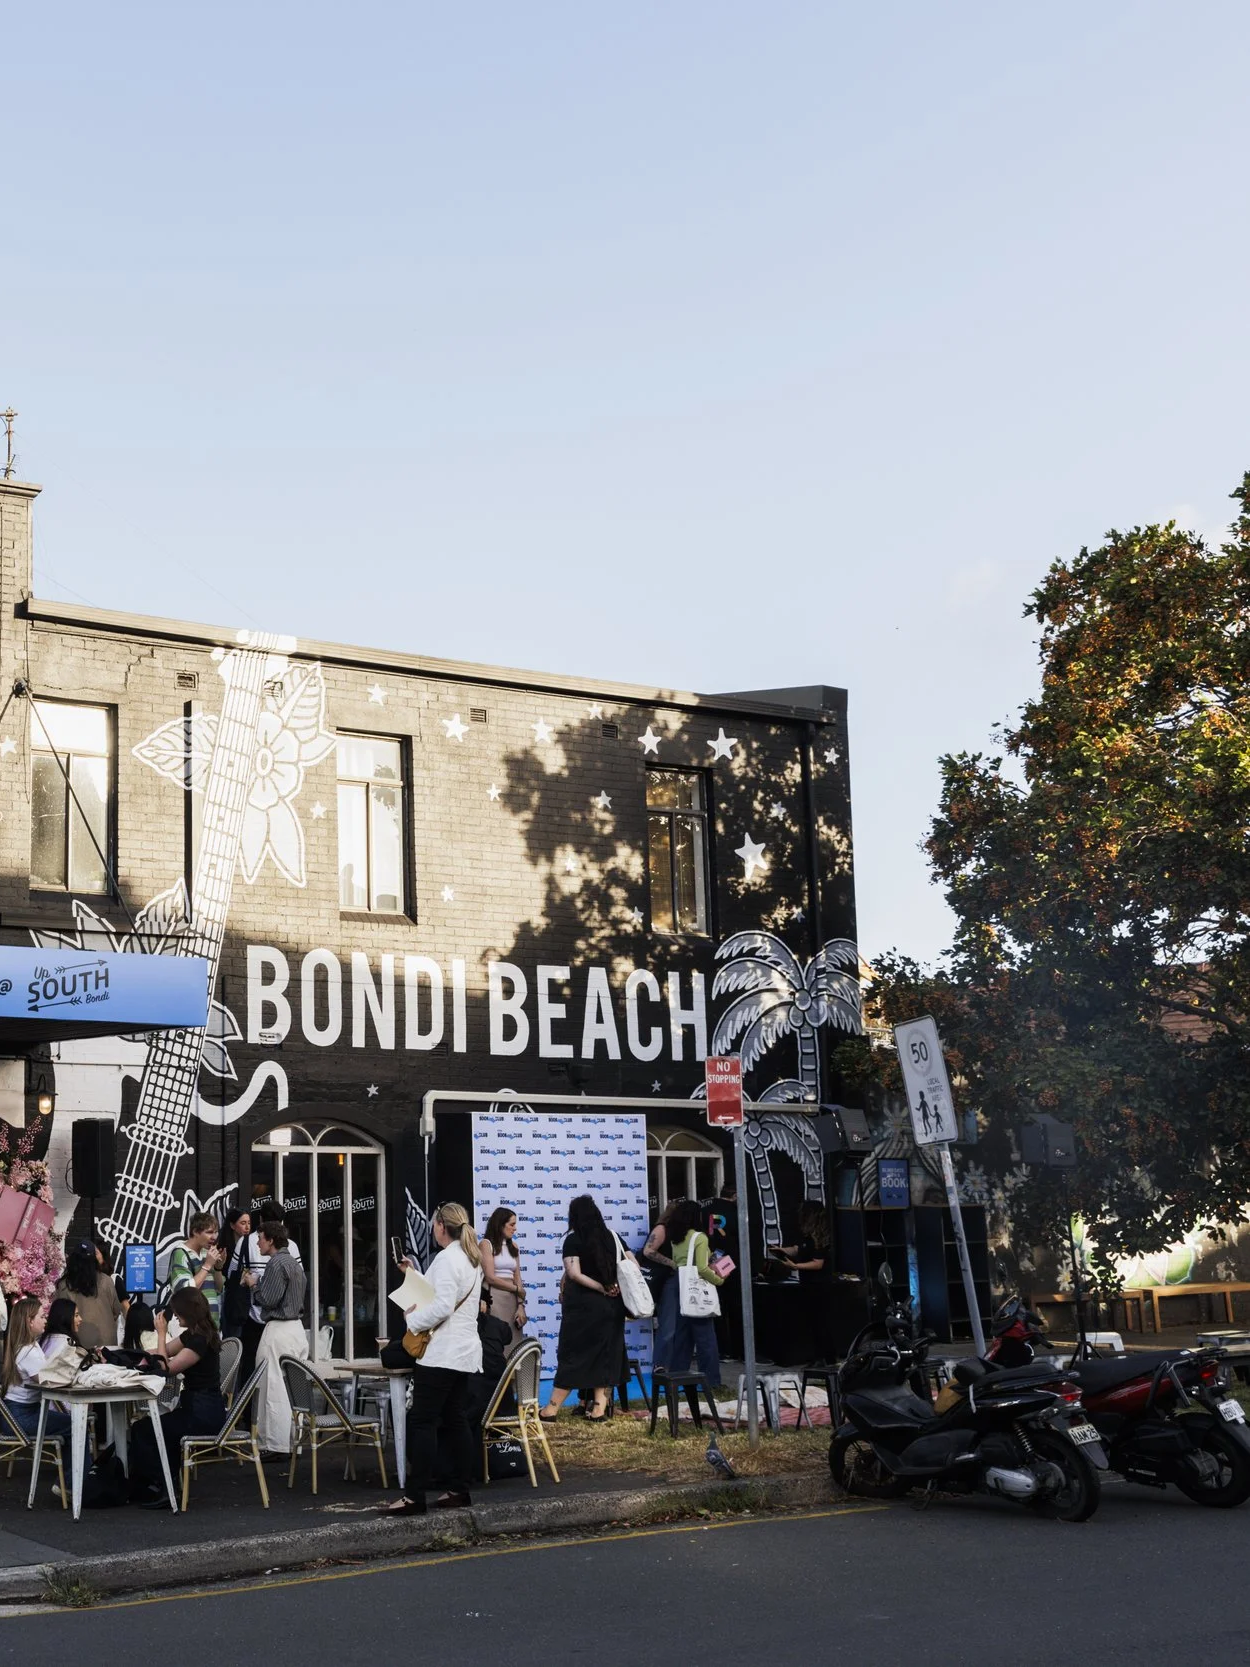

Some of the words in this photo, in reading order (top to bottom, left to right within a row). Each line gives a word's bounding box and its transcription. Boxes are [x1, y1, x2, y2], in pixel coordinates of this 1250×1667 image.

[33, 966, 50, 980] Up
[27, 968, 109, 1004] SOUTH
[85, 992, 110, 1005] Bondi
[246, 944, 467, 1053] BONDI
[488, 960, 708, 1062] BEACH
[911, 1041, 929, 1064] 50
[716, 1061, 731, 1072] NO
[707, 1074, 740, 1084] STOPPING
[283, 1197, 306, 1210] SOUTH
[318, 1197, 341, 1210] SOUTH
[352, 1198, 375, 1211] SOUTH
[708, 1214, 727, 1237] R
